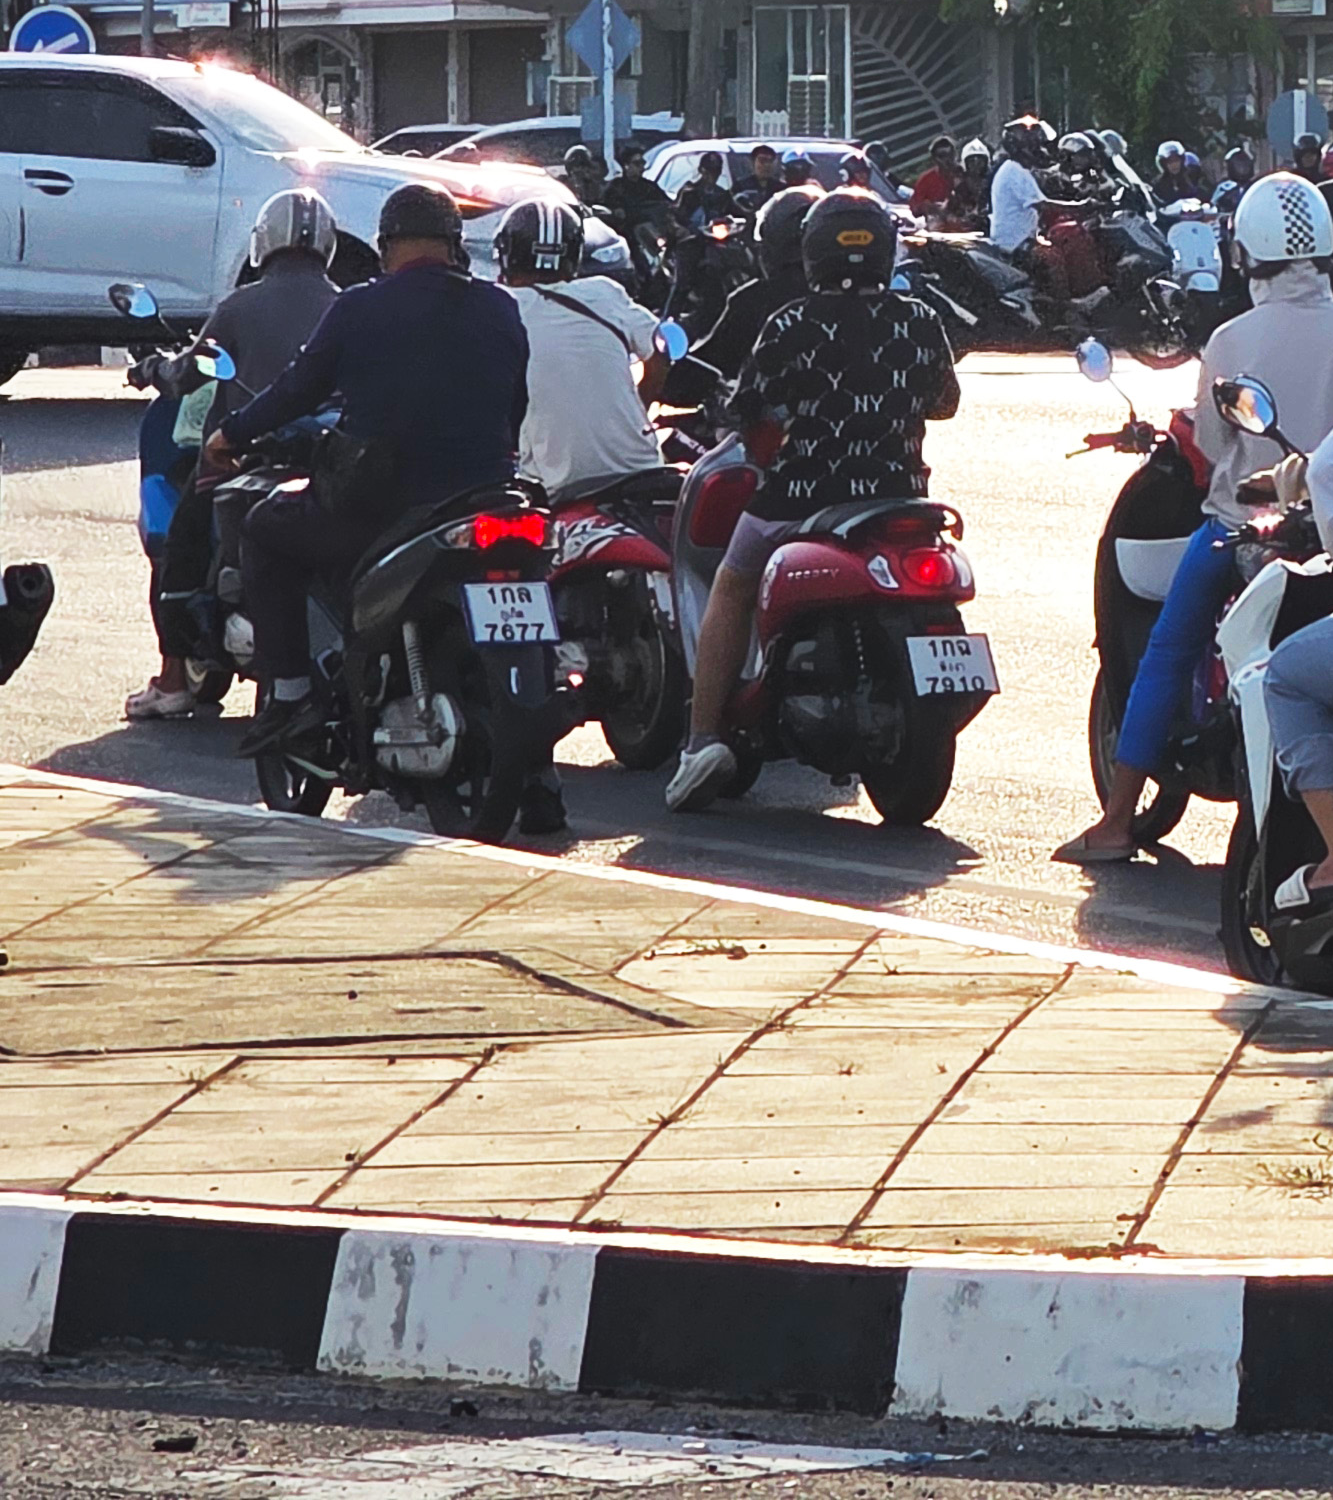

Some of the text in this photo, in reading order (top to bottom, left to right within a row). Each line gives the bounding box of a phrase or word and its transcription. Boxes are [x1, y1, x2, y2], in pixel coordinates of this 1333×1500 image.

[854, 394, 884, 413] NY
[787, 479, 817, 498] NY
[851, 478, 880, 496] NY
[487, 586, 532, 605] 1กล
[484, 623, 545, 641] 7677
[925, 675, 985, 693] 7910
